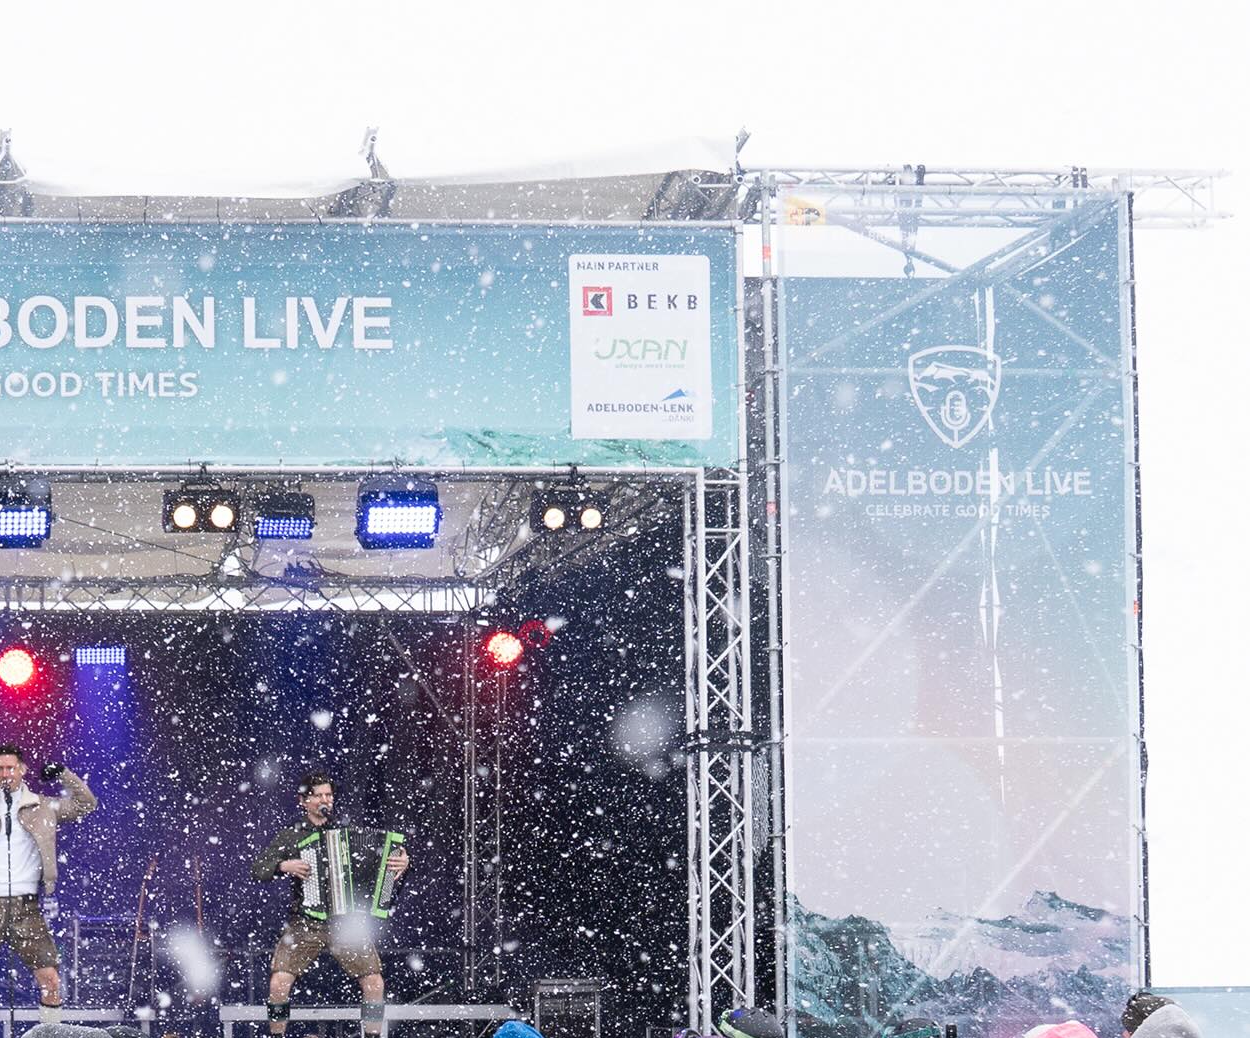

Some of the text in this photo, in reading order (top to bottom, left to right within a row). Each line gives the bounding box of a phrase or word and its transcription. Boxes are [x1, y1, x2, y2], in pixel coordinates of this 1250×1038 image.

[576, 262, 659, 271] MAIN PARTNER
[627, 294, 698, 310] BEKB
[243, 296, 393, 350] LIVE
[95, 372, 199, 399] TIMES
[823, 469, 1092, 496] ADELBODEN LIVE
[865, 503, 1051, 518] CELEBRATE GOOD TIMES
